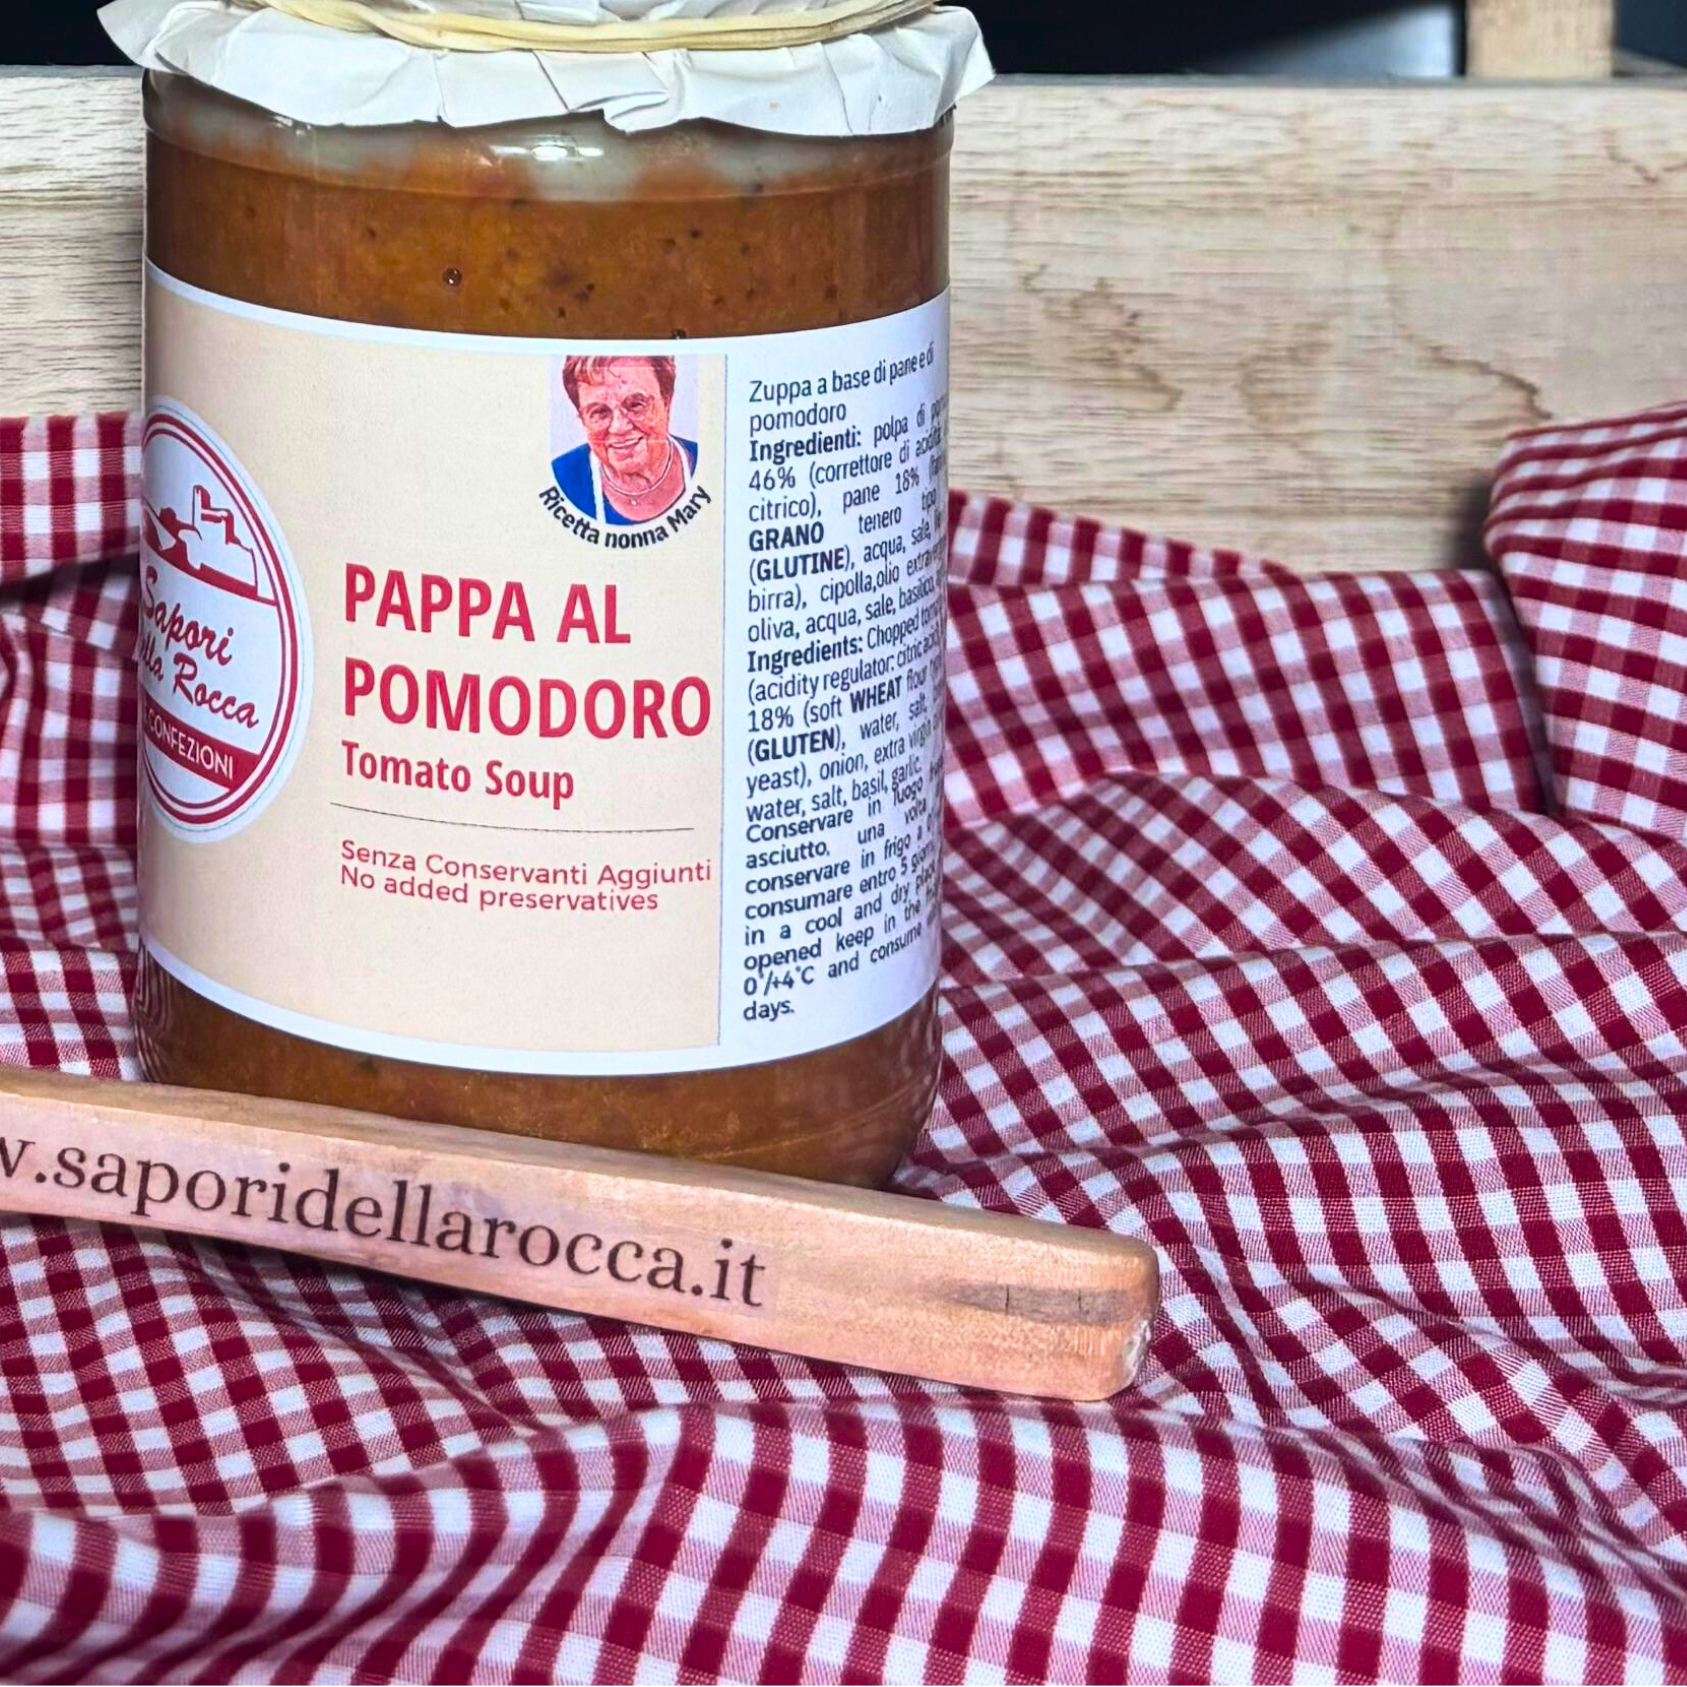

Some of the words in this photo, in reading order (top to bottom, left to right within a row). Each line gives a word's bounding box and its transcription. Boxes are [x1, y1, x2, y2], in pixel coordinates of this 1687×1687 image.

[749, 378, 812, 405] Zuppa
[817, 378, 827, 395] a
[832, 370, 870, 392] base
[874, 360, 886, 383] di
[890, 355, 917, 385] pane
[919, 352, 925, 368] e
[749, 402, 846, 436] pomodoro
[749, 430, 861, 466] Ingredienti:
[874, 415, 908, 447] polpa
[749, 466, 796, 491] 46%
[809, 450, 891, 487] (correttore
[900, 442, 910, 464] di
[749, 491, 821, 522] citrico),
[843, 483, 880, 512] pane
[895, 466, 920, 495] 18%
[540, 485, 601, 546] Ricetta
[604, 526, 668, 550] nonna
[666, 486, 712, 536] Mary
[749, 522, 824, 552] GRANO
[858, 506, 901, 534] tenero
[749, 545, 855, 586] (GLUTINE),
[864, 535, 906, 563] acqua,
[143, 564, 234, 667] Sapori
[344, 562, 534, 642] PAPPA
[556, 584, 631, 644] AL
[748, 617, 800, 642] oliva,
[806, 609, 861, 638] acqua,
[865, 593, 896, 621] sale,
[749, 583, 807, 612] birra),
[748, 637, 863, 675] Ingredients:
[867, 607, 919, 648] Chopped
[172, 651, 260, 729] Rocca
[344, 656, 711, 740] POMODORO
[748, 708, 794, 732] 18%
[803, 695, 842, 727] (soft
[850, 675, 903, 714] WHEAT
[749, 673, 819, 706] (acidity
[148, 709, 234, 781] CONFEZIONI
[746, 763, 811, 798] yeast),
[820, 749, 868, 782] onion,
[874, 733, 905, 763] extra
[747, 723, 846, 766] (GLUTEN),
[860, 711, 900, 743] water,
[341, 740, 471, 792] Tomato
[485, 759, 574, 810] Soup
[746, 797, 806, 823] water,
[812, 784, 847, 810] salt,
[852, 771, 889, 802] basil,
[746, 809, 853, 843] Conservare
[868, 796, 881, 818] in
[858, 820, 885, 845] una
[340, 840, 416, 872] Senza
[426, 854, 588, 886] Conservanti
[598, 858, 712, 890] Aggiunti
[340, 863, 376, 890] No
[384, 876, 468, 906] added
[480, 888, 658, 912] preservatives
[745, 882, 853, 920] consumare
[860, 861, 897, 893] entro
[900, 856, 908, 876] 5
[746, 858, 850, 894] conservare
[861, 849, 875, 870] in
[884, 834, 911, 860] frigo
[744, 938, 821, 973] opened
[836, 923, 874, 952] keep
[884, 913, 896, 934] in
[904, 900, 921, 921] the
[745, 925, 764, 945] in
[780, 922, 791, 940] a
[806, 906, 843, 934] cool
[854, 892, 883, 921] and
[891, 882, 910, 905] dry
[828, 951, 859, 978] and
[870, 922, 922, 963] consume
[743, 997, 795, 1021] days.
